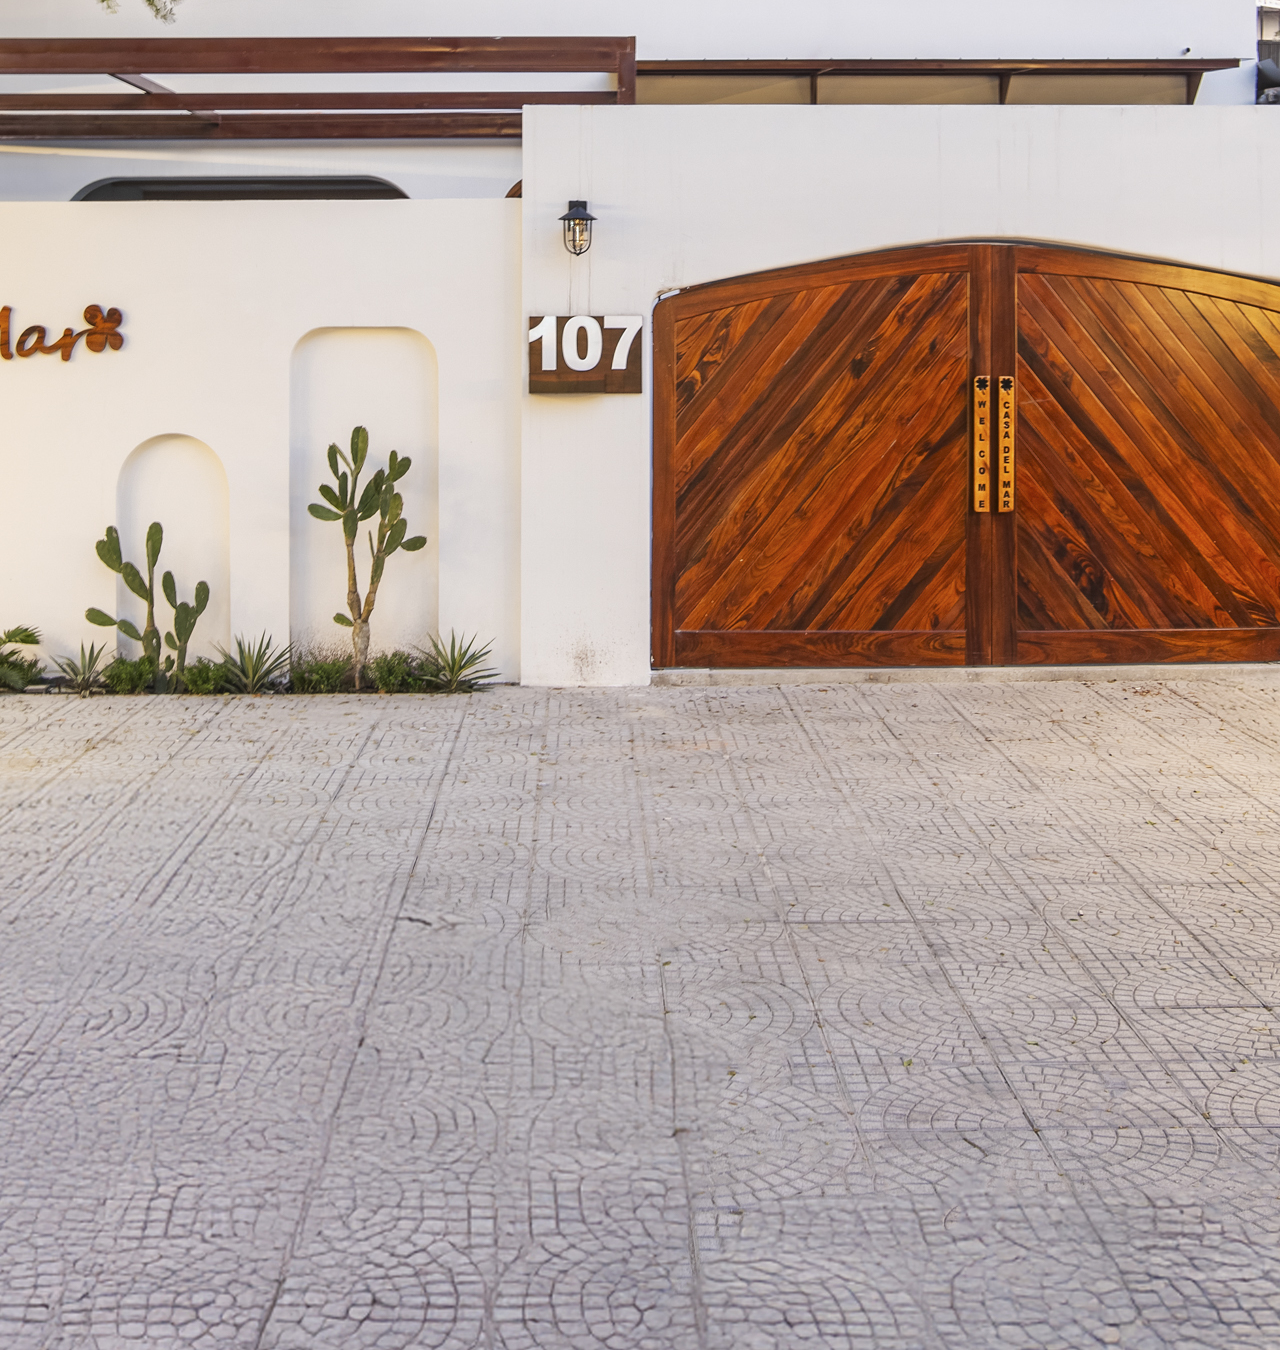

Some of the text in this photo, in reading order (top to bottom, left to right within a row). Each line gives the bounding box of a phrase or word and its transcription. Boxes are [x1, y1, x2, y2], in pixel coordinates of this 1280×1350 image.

[528, 315, 643, 372] 107
[978, 401, 986, 508] WELCOME
[1003, 481, 1011, 508] MAR
